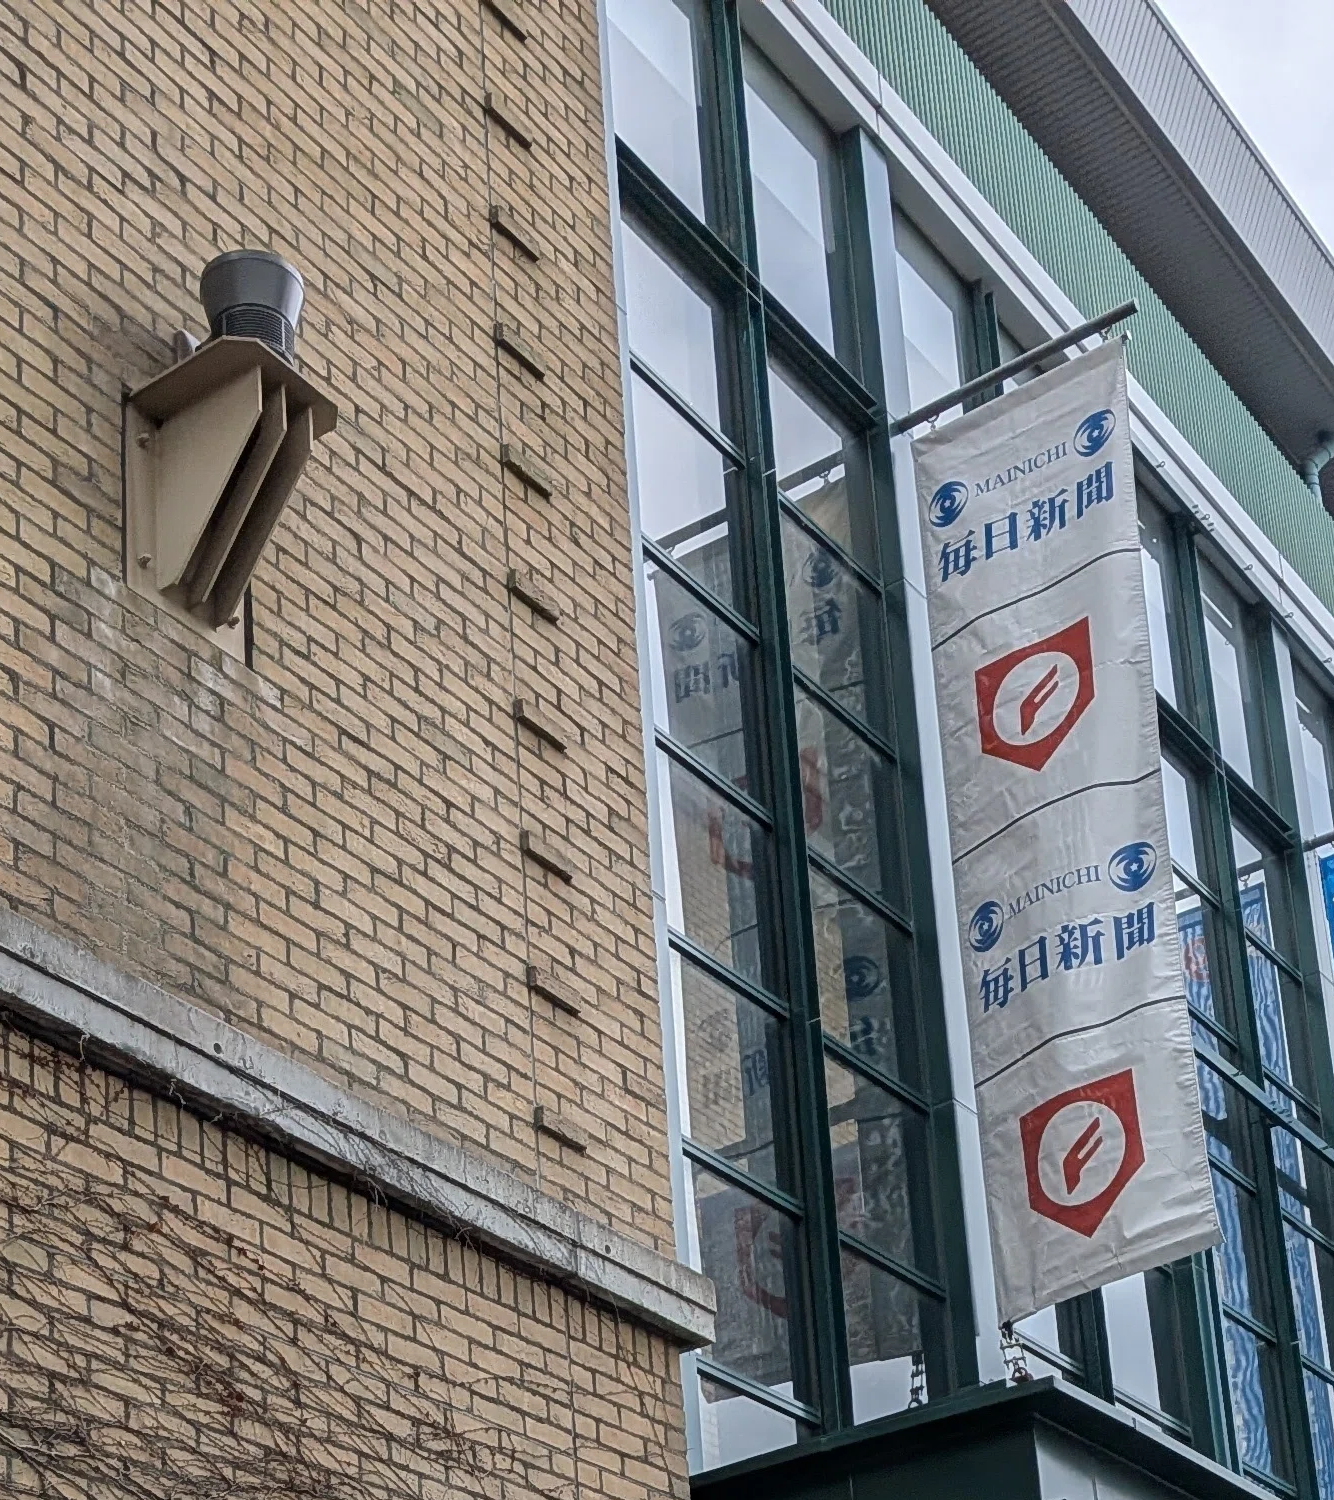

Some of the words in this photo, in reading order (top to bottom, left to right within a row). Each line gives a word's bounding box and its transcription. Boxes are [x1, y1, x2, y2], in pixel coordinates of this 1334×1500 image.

[973, 440, 1068, 498] MAINICHI
[937, 460, 1116, 583] 毎日新聞
[1005, 863, 1102, 921] MAINICHI
[979, 901, 1157, 1014] 毎日新聞
